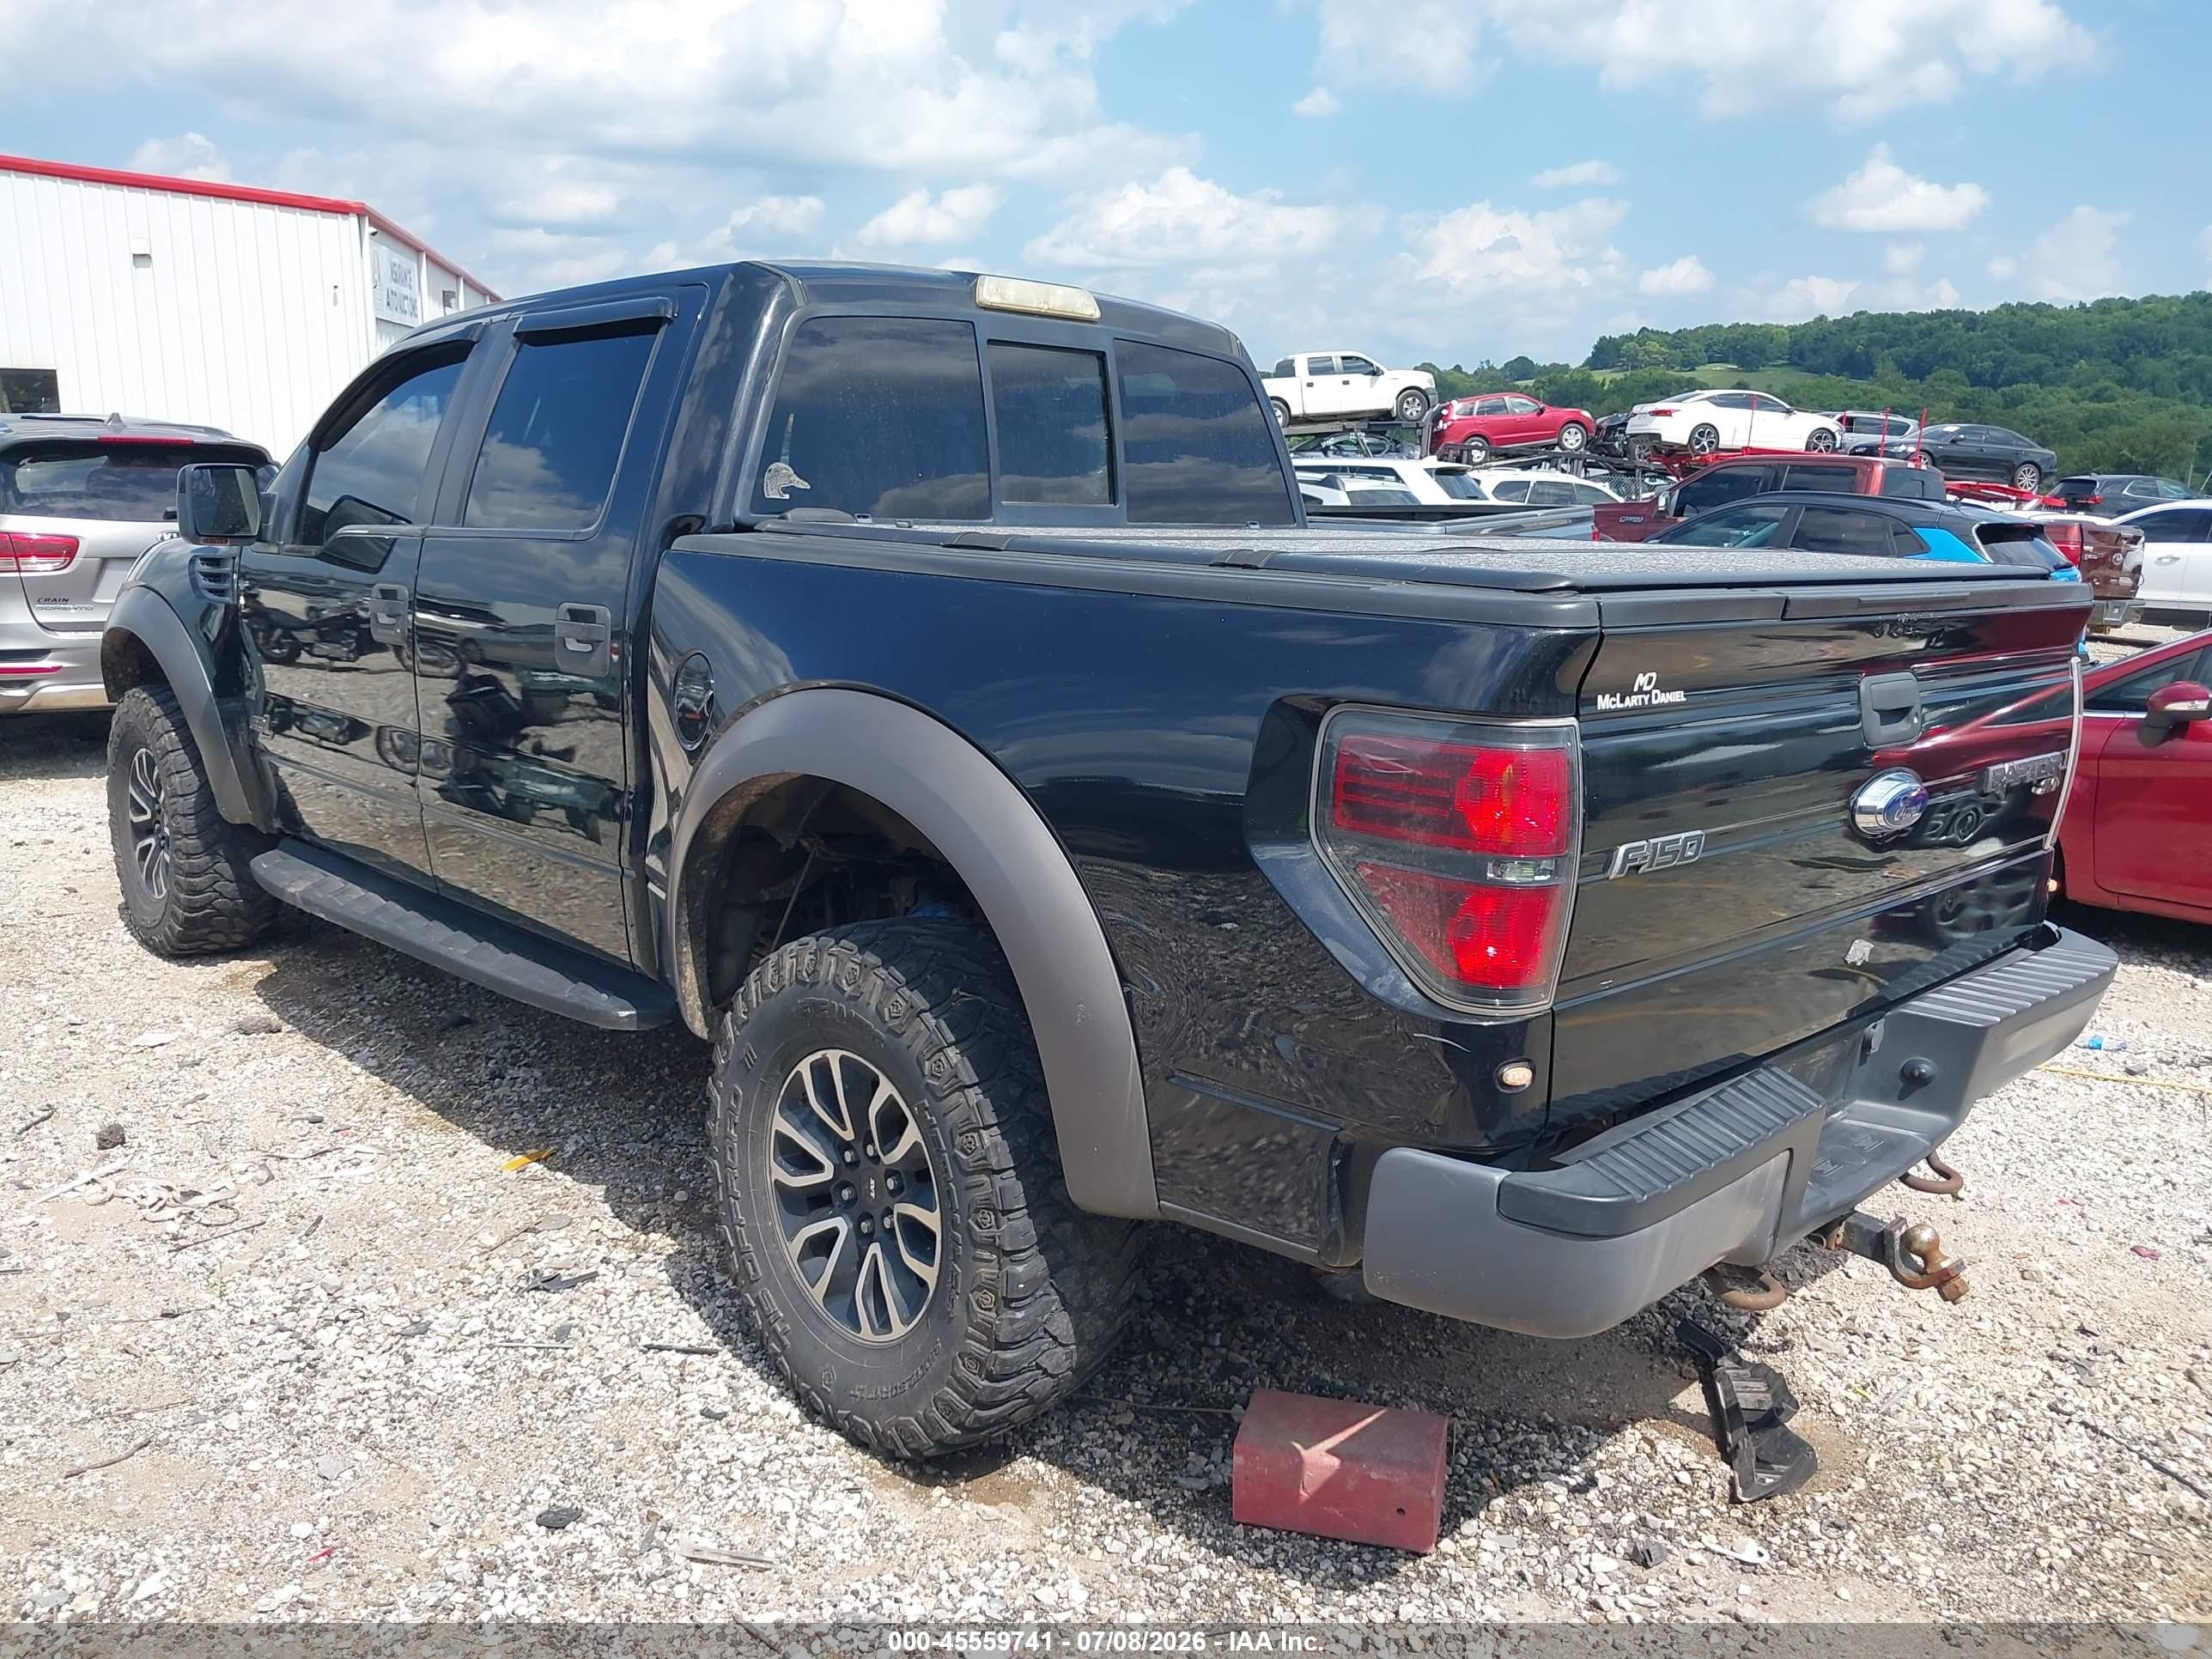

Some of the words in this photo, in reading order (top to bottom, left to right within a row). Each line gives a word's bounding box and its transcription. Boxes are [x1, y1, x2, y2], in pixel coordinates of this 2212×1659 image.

[1633, 672, 1657, 692] MD
[1597, 692, 1650, 710] McLARTY
[1651, 689, 1687, 705] DANIEL
[1607, 830, 1705, 880] F-150
